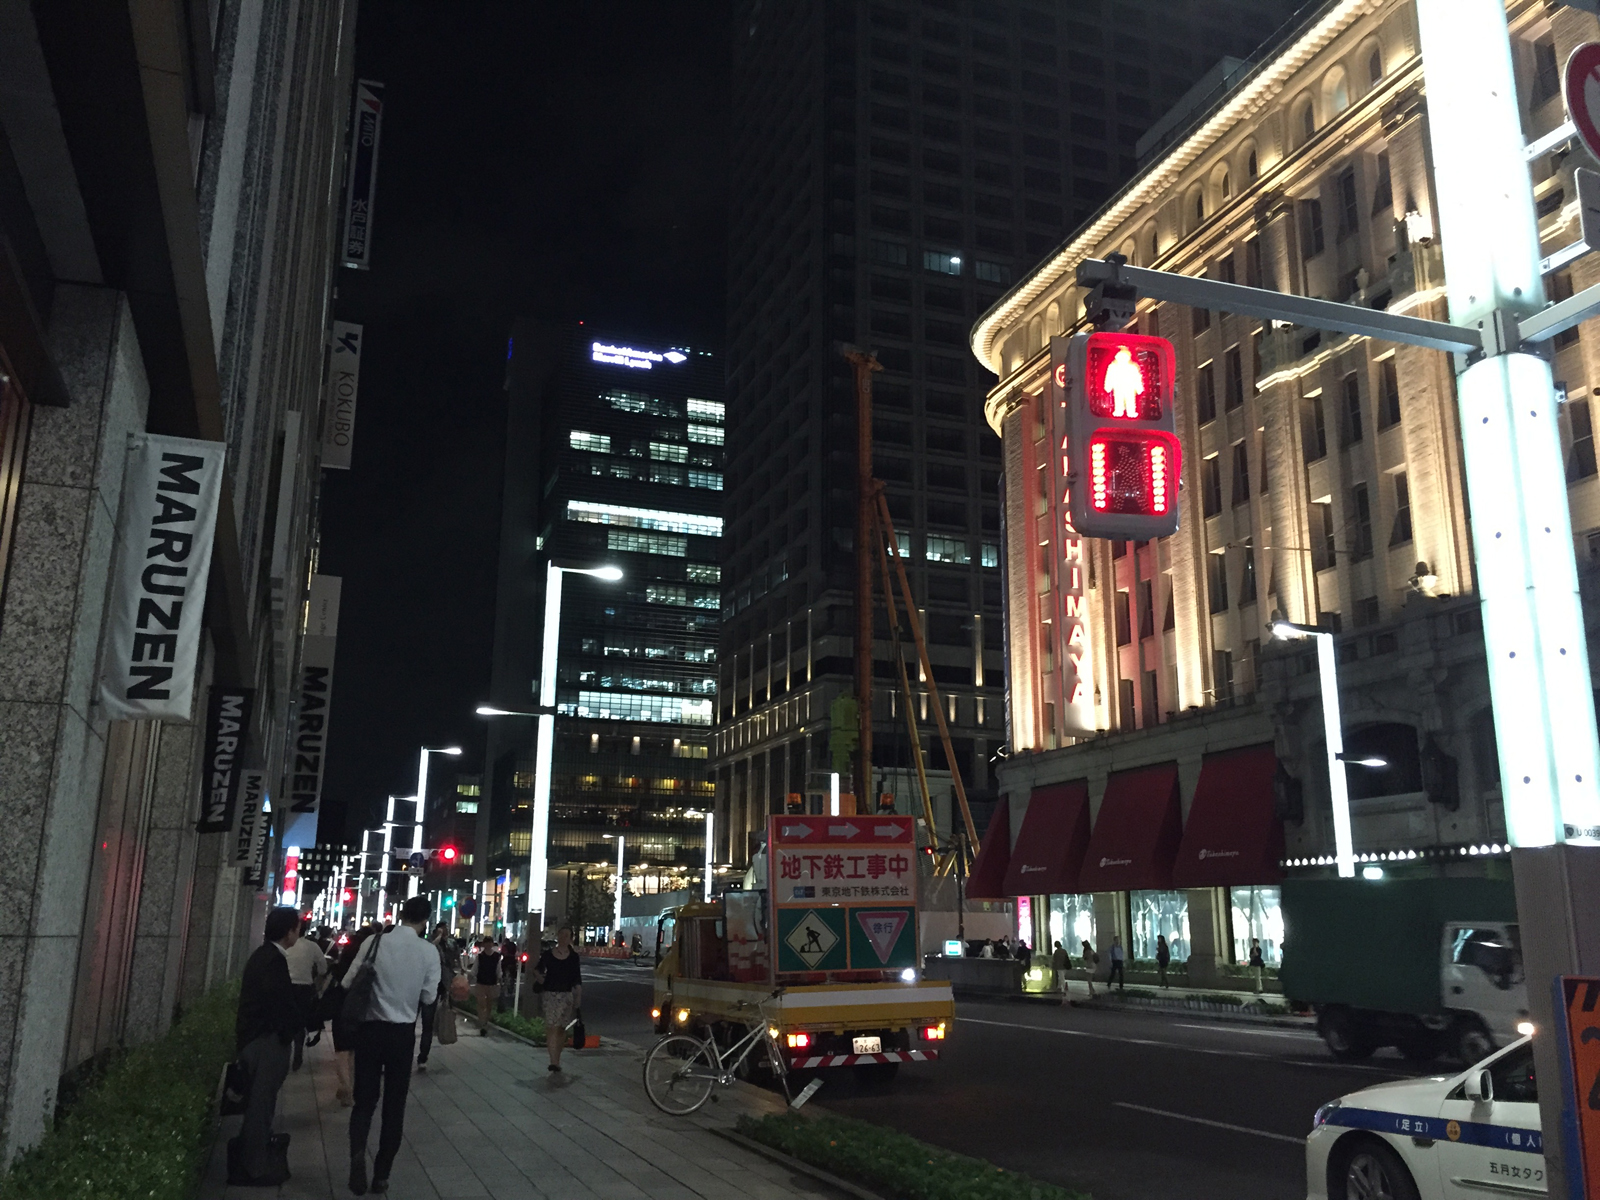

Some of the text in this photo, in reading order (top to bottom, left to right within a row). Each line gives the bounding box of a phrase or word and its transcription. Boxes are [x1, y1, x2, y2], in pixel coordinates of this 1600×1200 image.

[360, 113, 375, 147] MITO
[348, 199, 368, 255] 水戸証券
[334, 371, 355, 446] KOKUBO
[126, 452, 204, 701] MARUZEN
[207, 695, 245, 823] MARUZEN
[291, 666, 329, 813] MARUZEN
[237, 776, 261, 861] MARUZEN
[781, 853, 909, 880] 地下鉄工事中
[821, 886, 909, 898] 東京地下鉄株式会社
[873, 922, 893, 934] 徐行
[859, 1044, 880, 1052] 26-63
